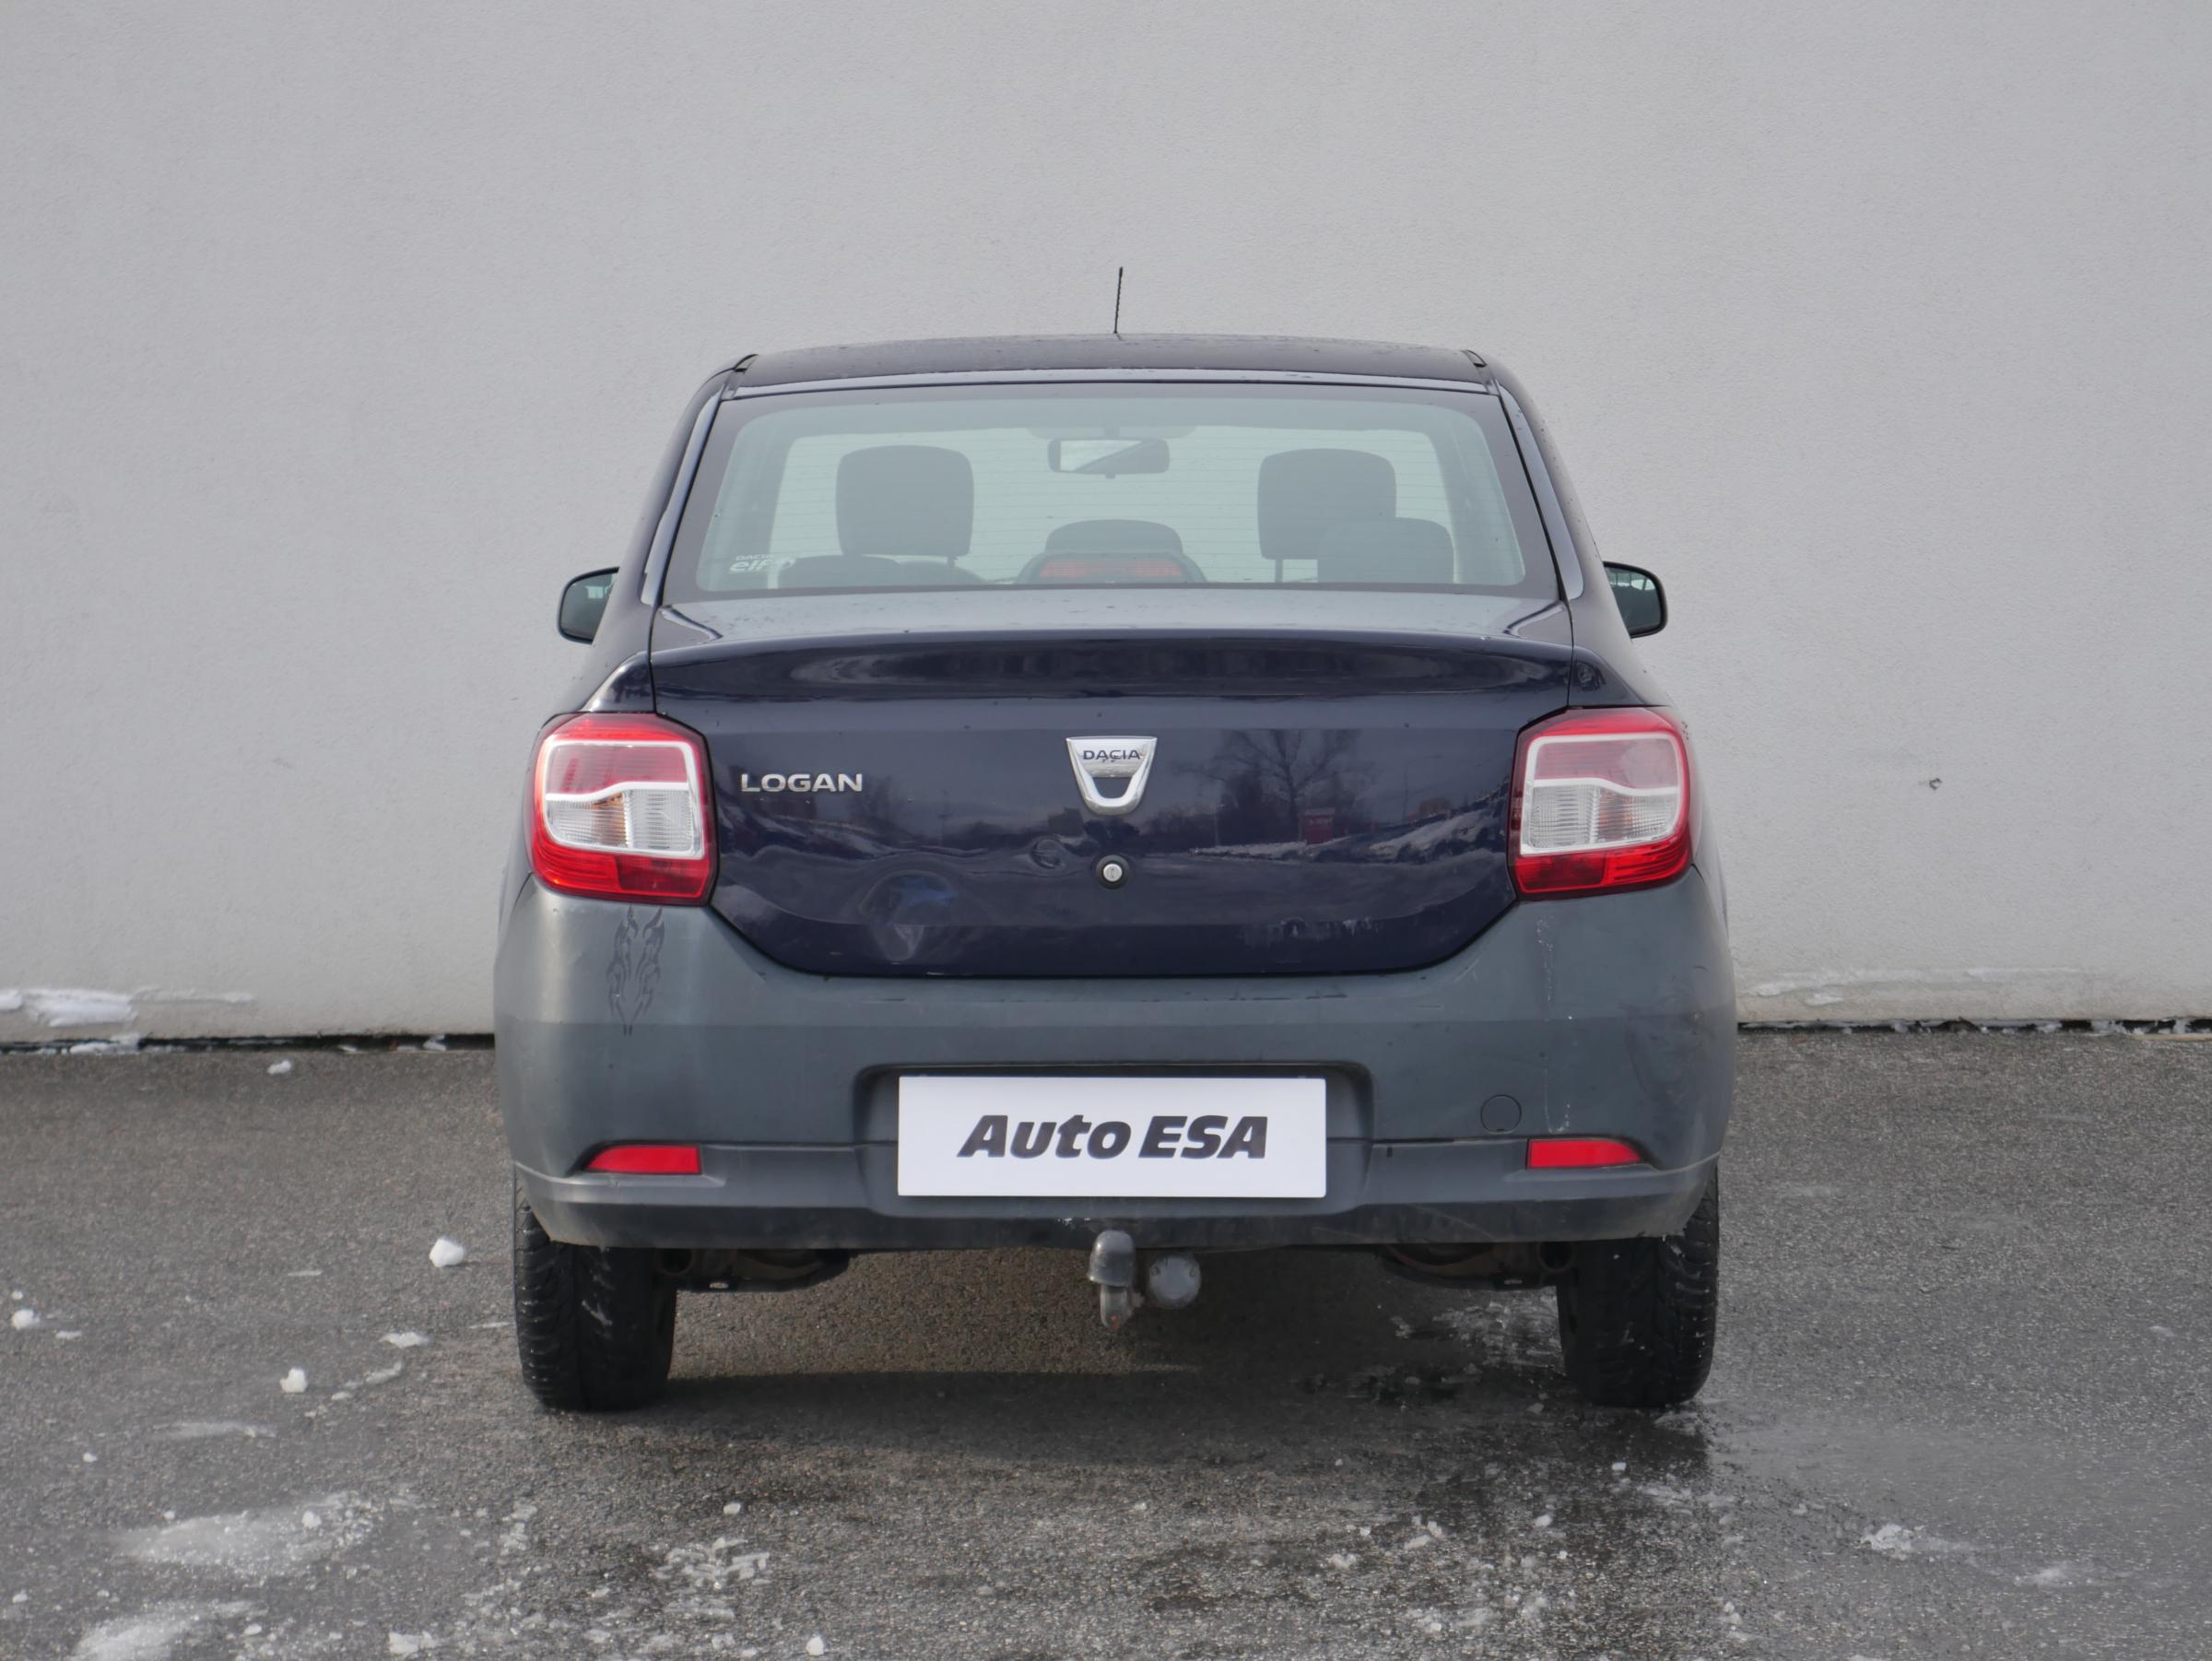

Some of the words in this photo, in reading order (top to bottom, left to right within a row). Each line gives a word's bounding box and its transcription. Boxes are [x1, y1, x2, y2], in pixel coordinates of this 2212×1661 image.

[1083, 749, 1141, 760] DACIA
[740, 772, 864, 793] LOGAN
[957, 1113, 1133, 1160] Auto
[1138, 1114, 1268, 1160] ESA
